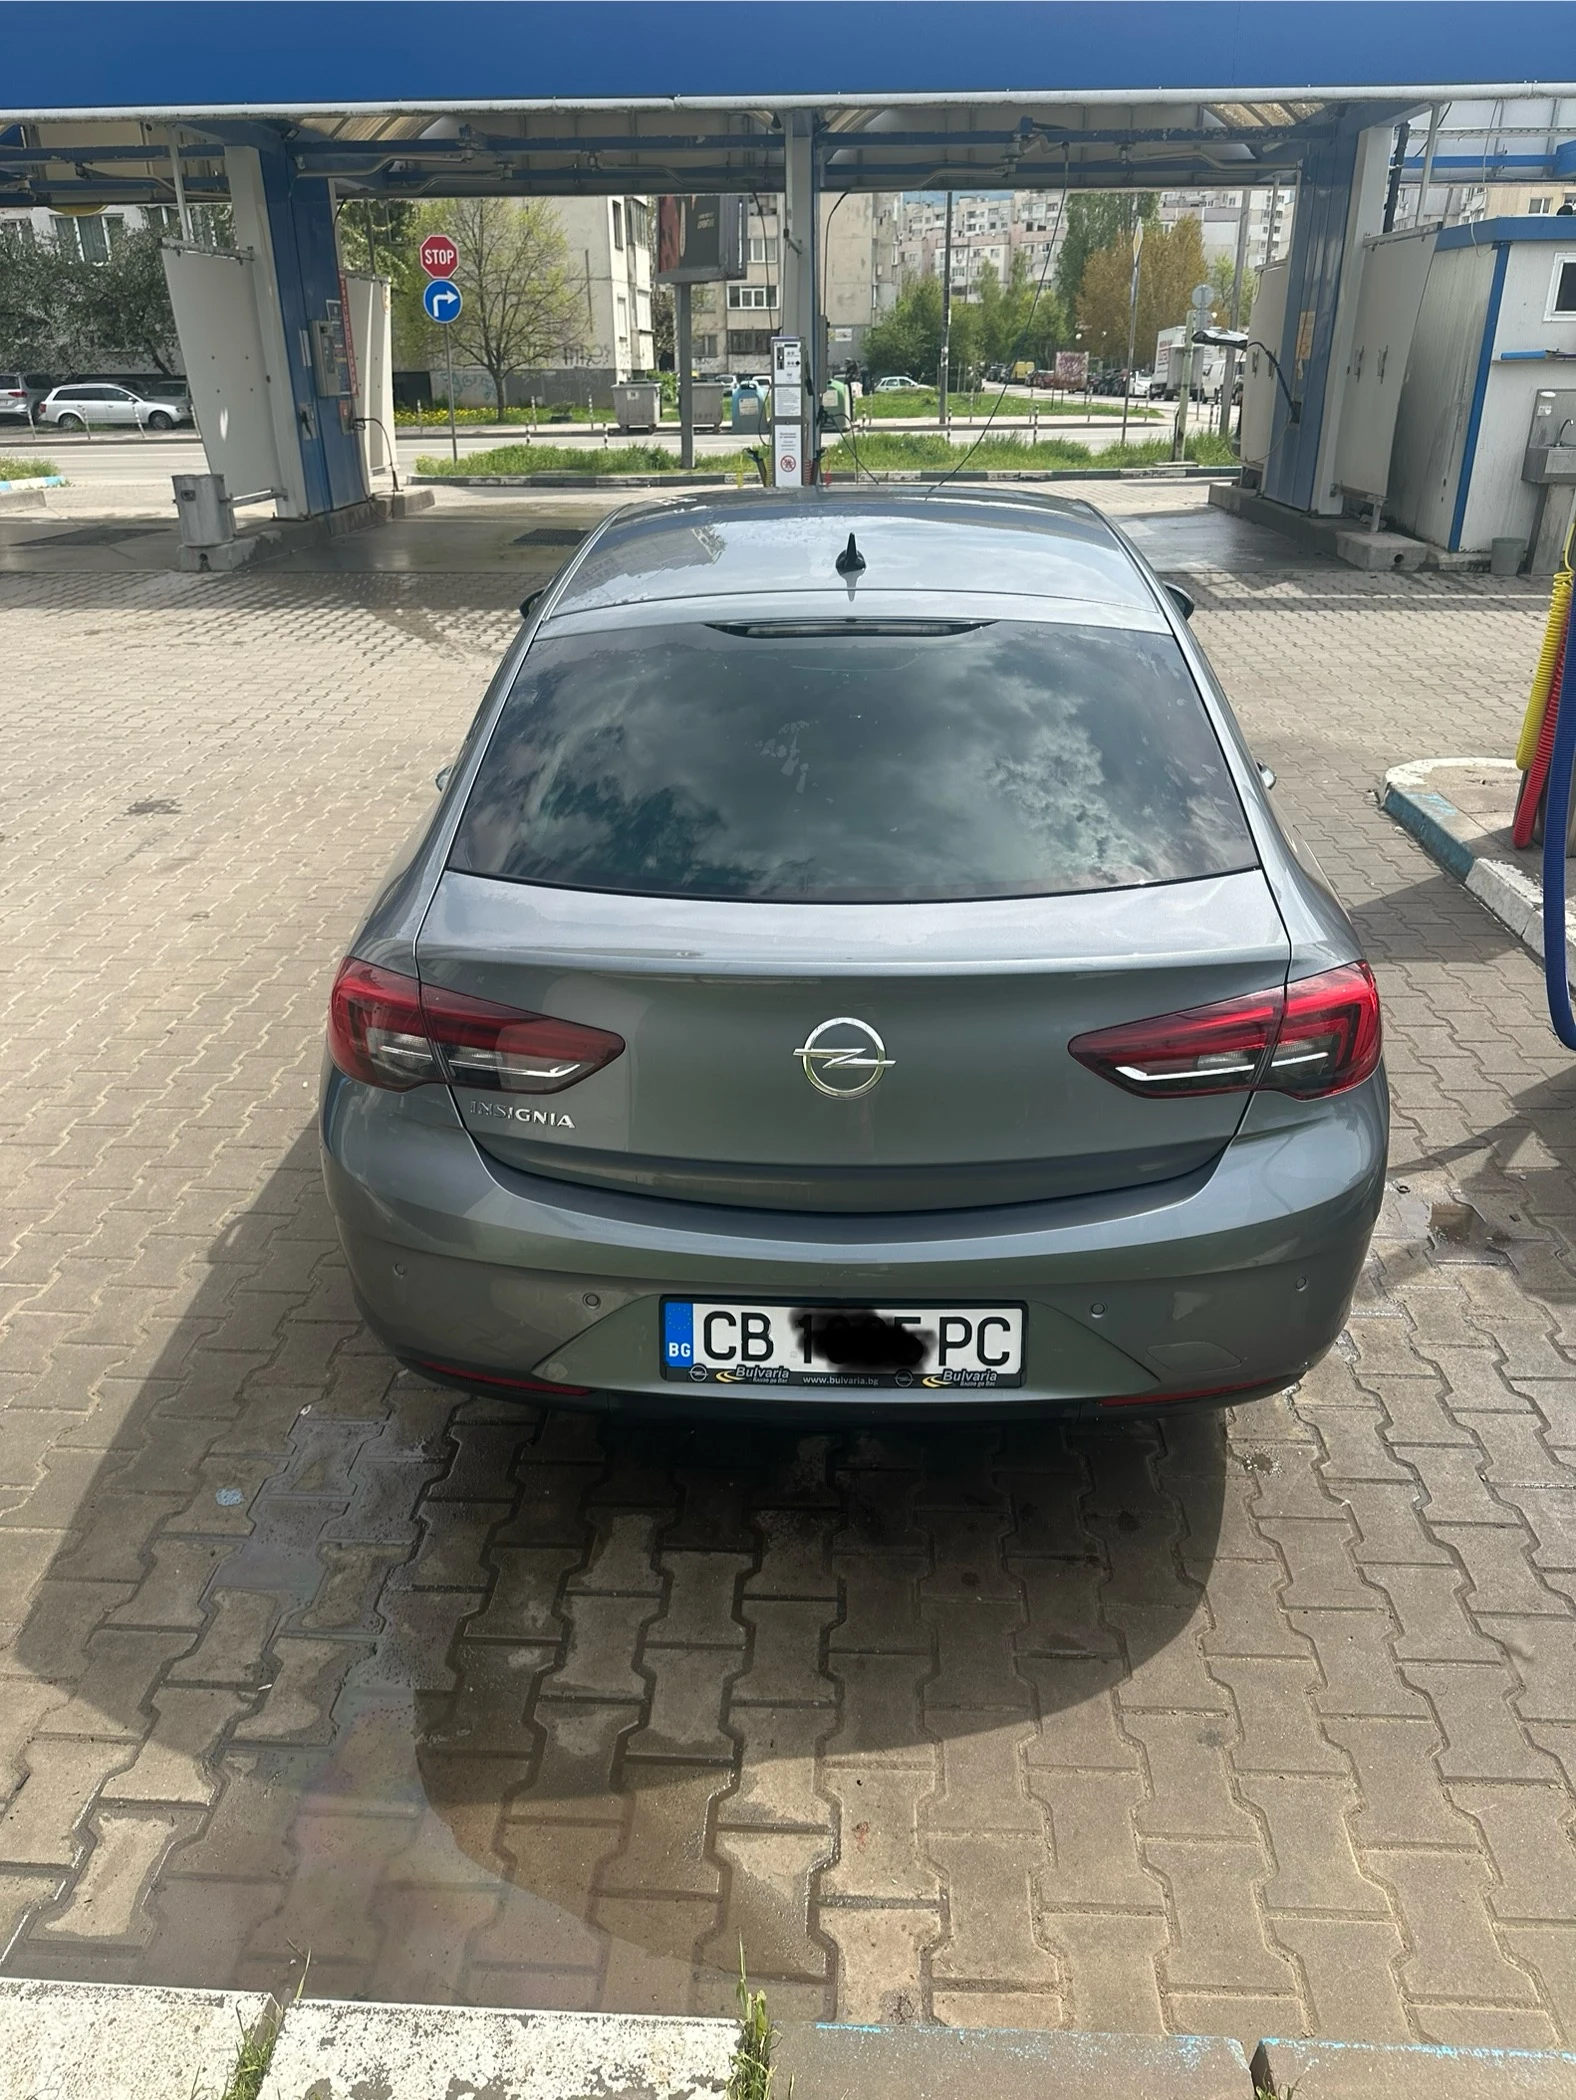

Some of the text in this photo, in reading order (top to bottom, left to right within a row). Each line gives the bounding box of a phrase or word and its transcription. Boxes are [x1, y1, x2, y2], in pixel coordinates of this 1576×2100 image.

[424, 249, 455, 265] STOP
[470, 1100, 576, 1129] INSIGNIA
[703, 1310, 774, 1361] CB
[938, 1316, 1011, 1366] PC
[668, 1342, 691, 1358] BG
[735, 1366, 790, 1379] Bulvaria
[943, 1370, 998, 1382] Bulvaria
[802, 1375, 880, 1387] www.bulvaria.bg
